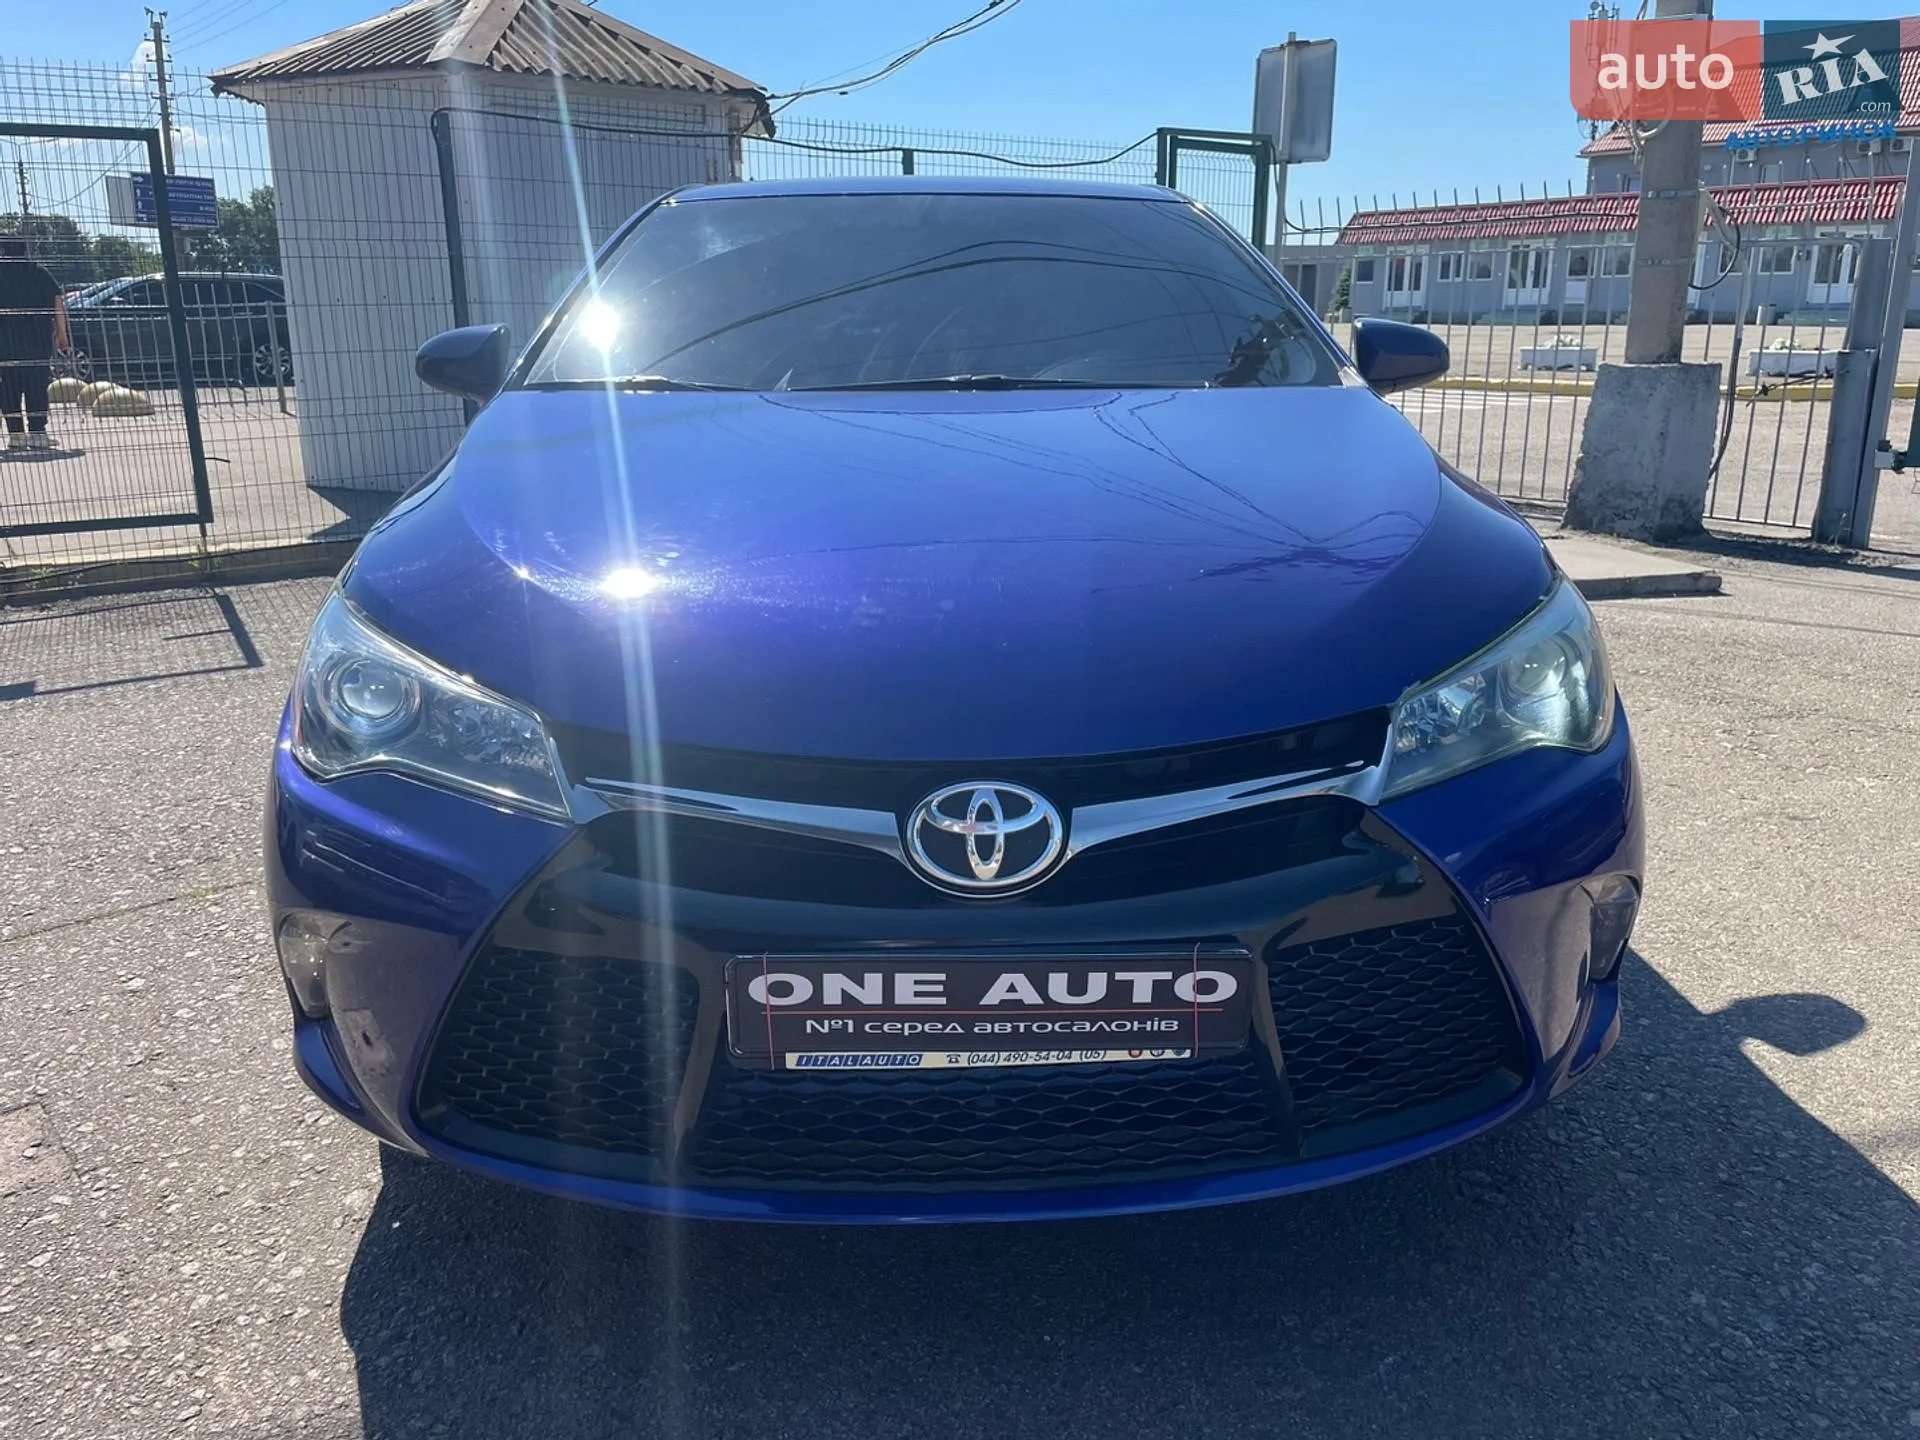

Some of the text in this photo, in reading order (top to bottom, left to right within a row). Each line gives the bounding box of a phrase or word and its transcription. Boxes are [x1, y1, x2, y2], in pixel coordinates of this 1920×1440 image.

[1724, 121, 1896, 150] АВТОРИНОК
[748, 970, 1238, 1006] ONE AUTO
[864, 1021, 965, 1036] серед
[973, 1017, 1179, 1034] автосалонів
[799, 1054, 922, 1067] ITALAUTO
[967, 1051, 1000, 1066] (044)
[1003, 1050, 1072, 1063] 490-54-04
